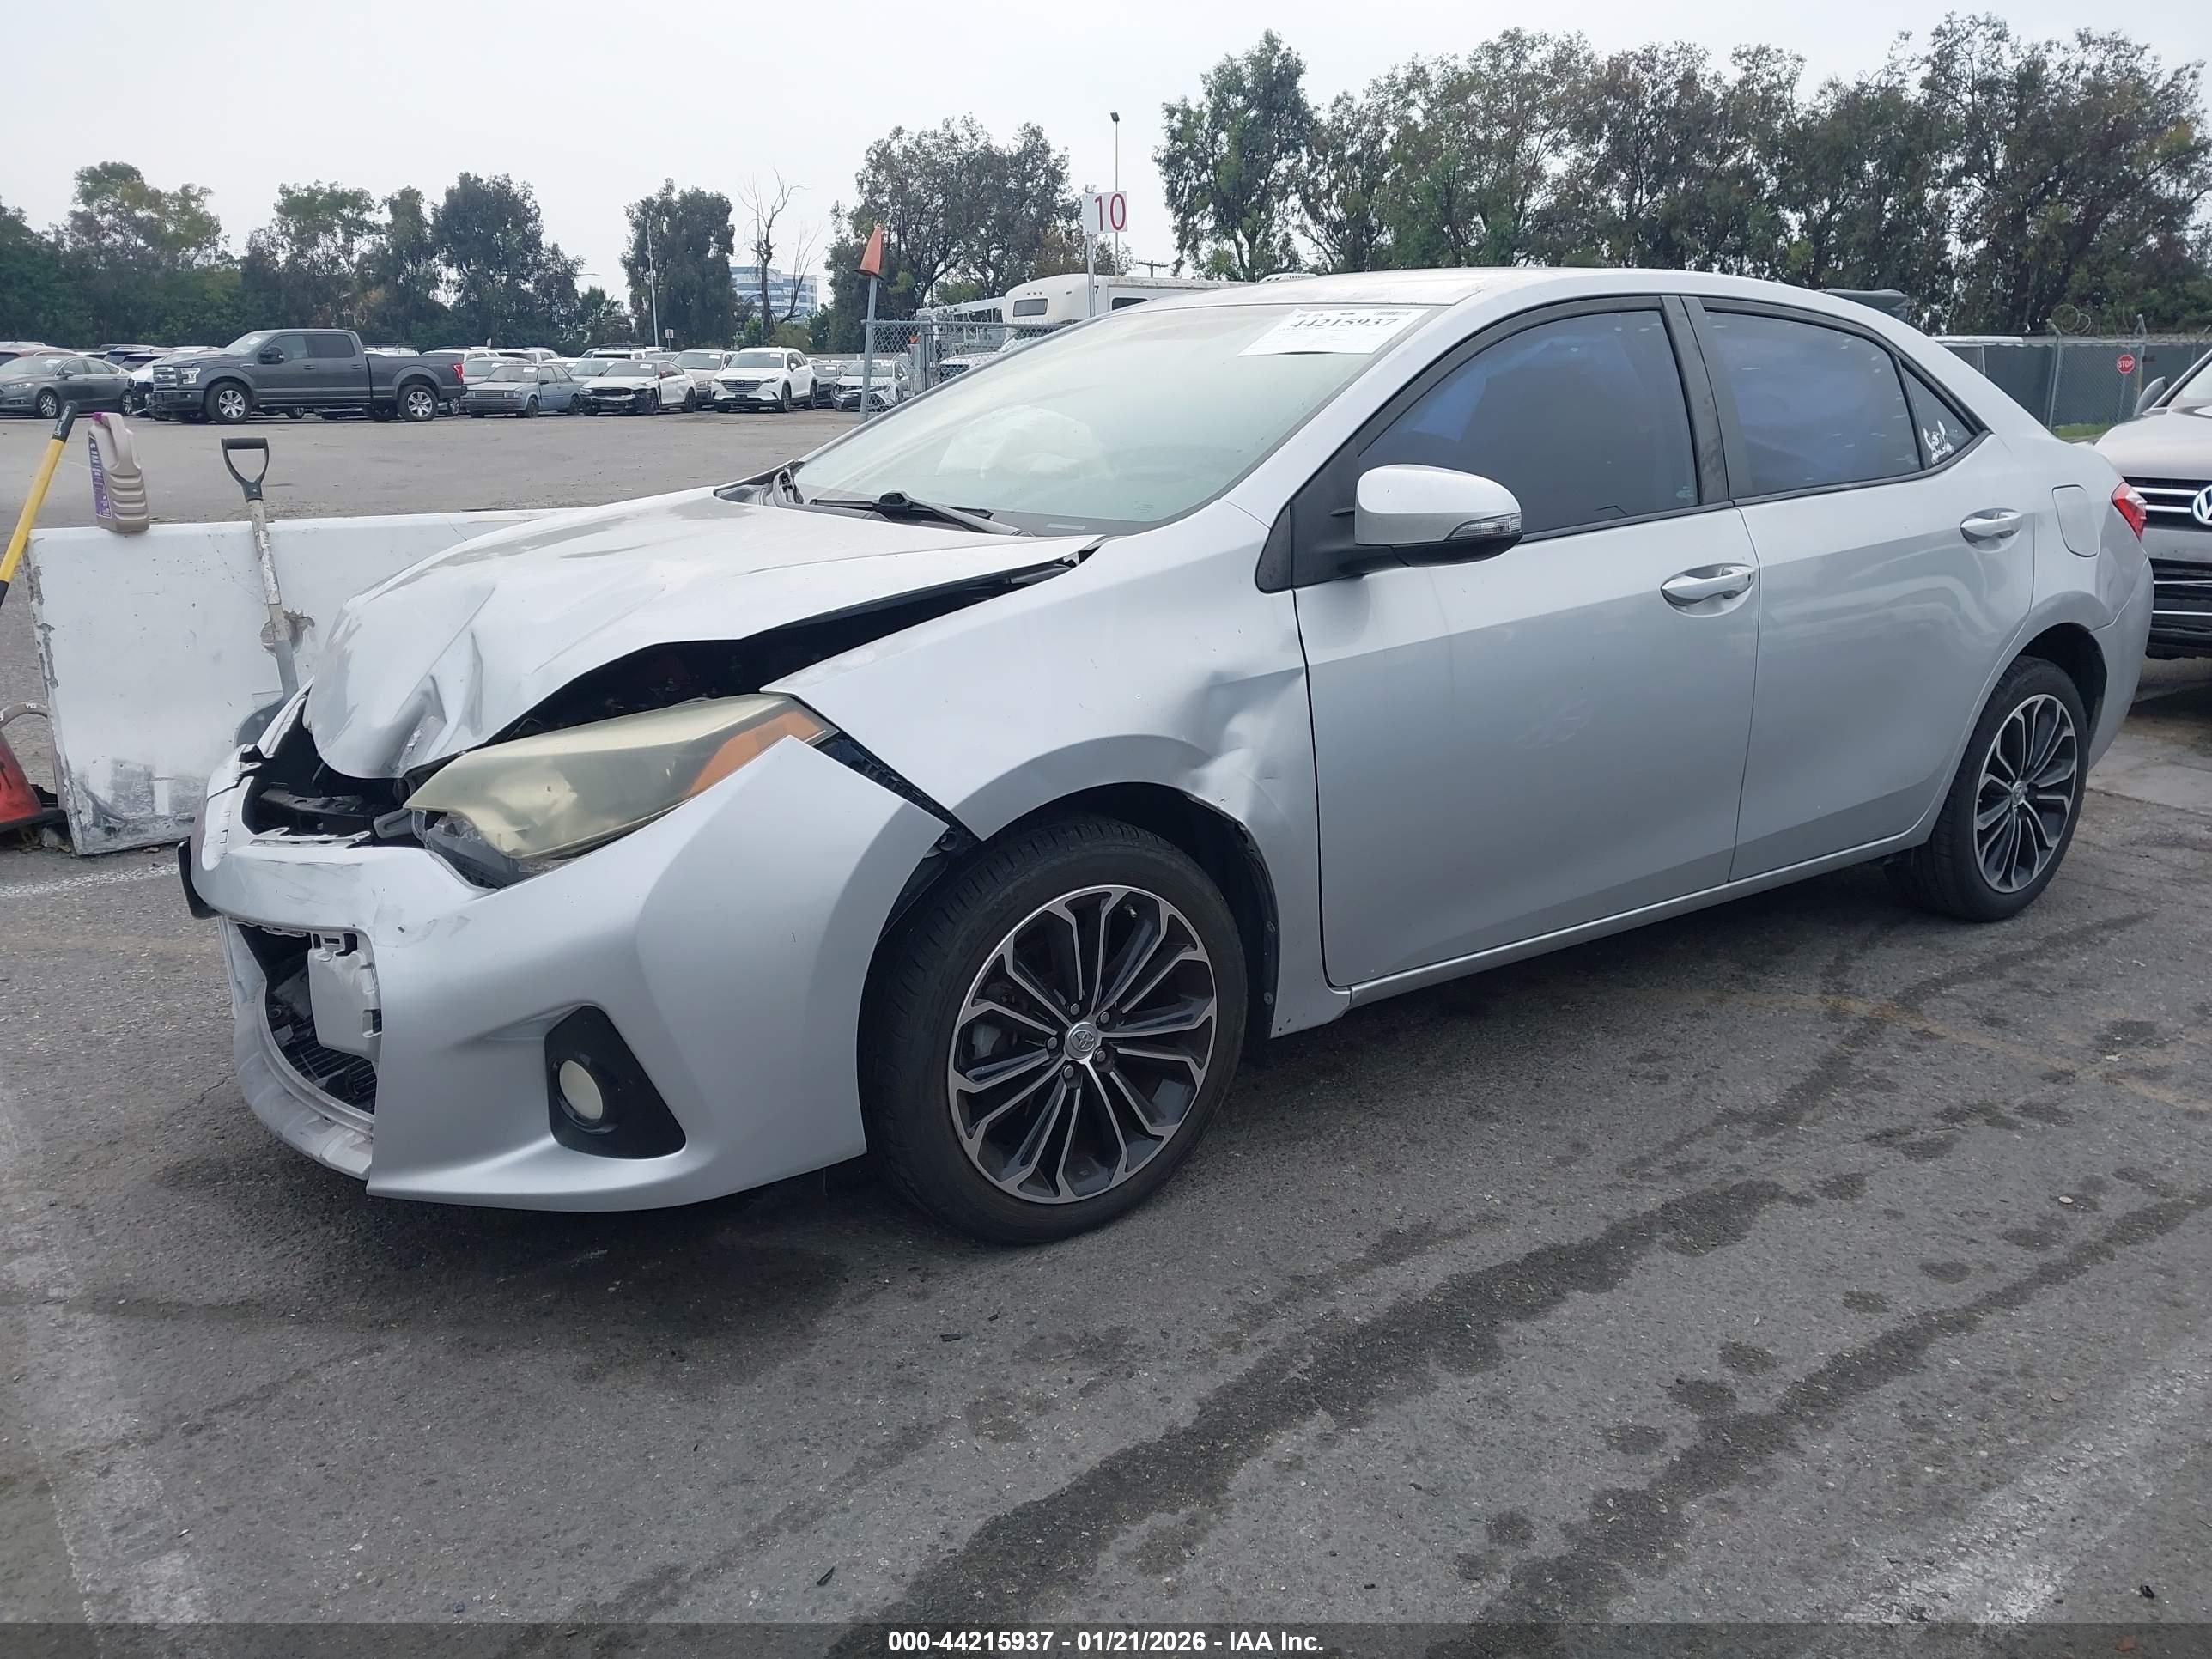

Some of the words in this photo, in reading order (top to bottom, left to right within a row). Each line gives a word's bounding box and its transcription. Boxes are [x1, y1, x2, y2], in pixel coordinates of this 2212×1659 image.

[1094, 193, 1127, 231] 10
[1290, 318, 1399, 327] 44215937
[2118, 360, 2134, 368] STOP
